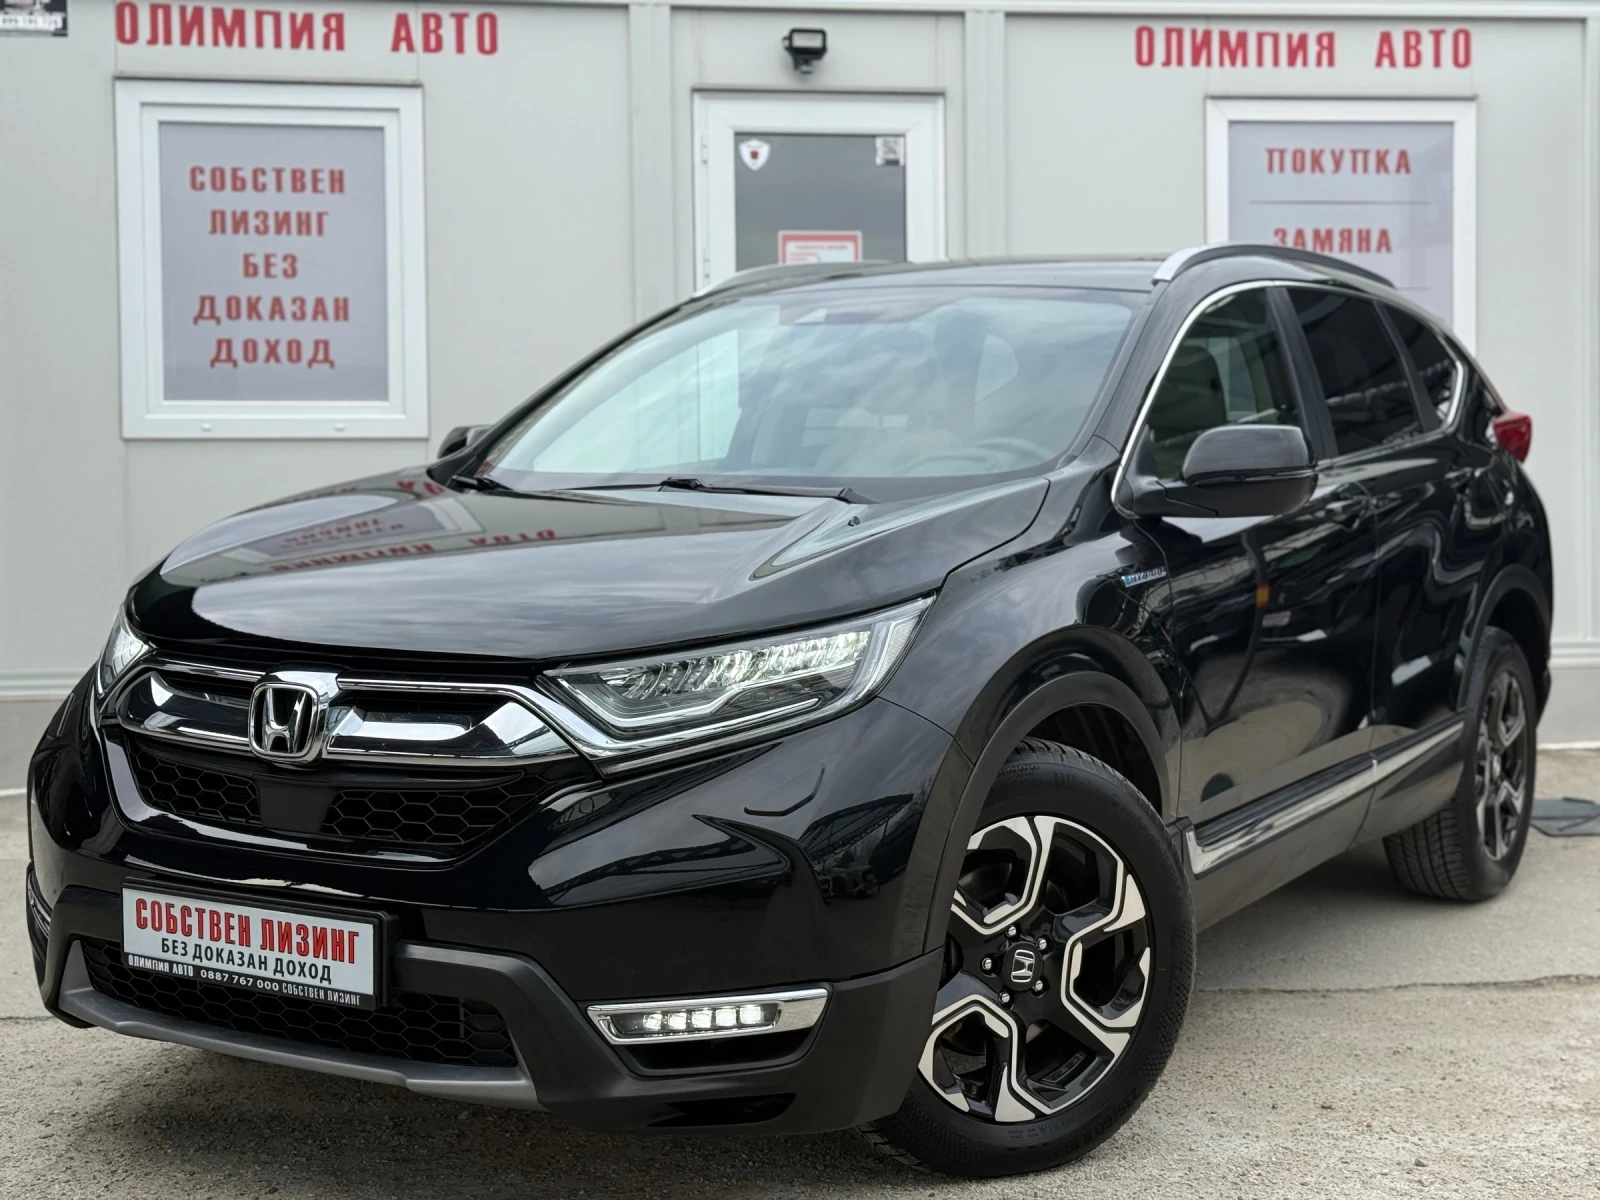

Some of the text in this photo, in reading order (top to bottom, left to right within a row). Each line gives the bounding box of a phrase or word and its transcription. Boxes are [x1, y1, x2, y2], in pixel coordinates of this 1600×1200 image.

[114, 0, 346, 52] ОЛИМПИЯ
[390, 11, 499, 56] АВТО
[1134, 25, 1472, 69] ОЛИМПИЯ АВТО
[1266, 148, 1412, 174] ПОКУПКА
[189, 166, 346, 194] СОБСТВЕН
[210, 210, 328, 236] ЛИЗИНГ
[1274, 227, 1392, 254] ЗАМЯНА
[242, 253, 298, 279] БЕЗ
[193, 295, 349, 325] ДОКАЗАН
[210, 338, 335, 368] ДОХОД
[135, 897, 360, 965] СОБСТВЕН ЛИЗИНГ
[161, 937, 332, 986] БЕЗ ДОКАЗАН ДОХОД
[128, 954, 361, 1007] ОЛИМПИЯ АВТО 0887 767 000 СОБСТВЕН ЛИЗИНГ
